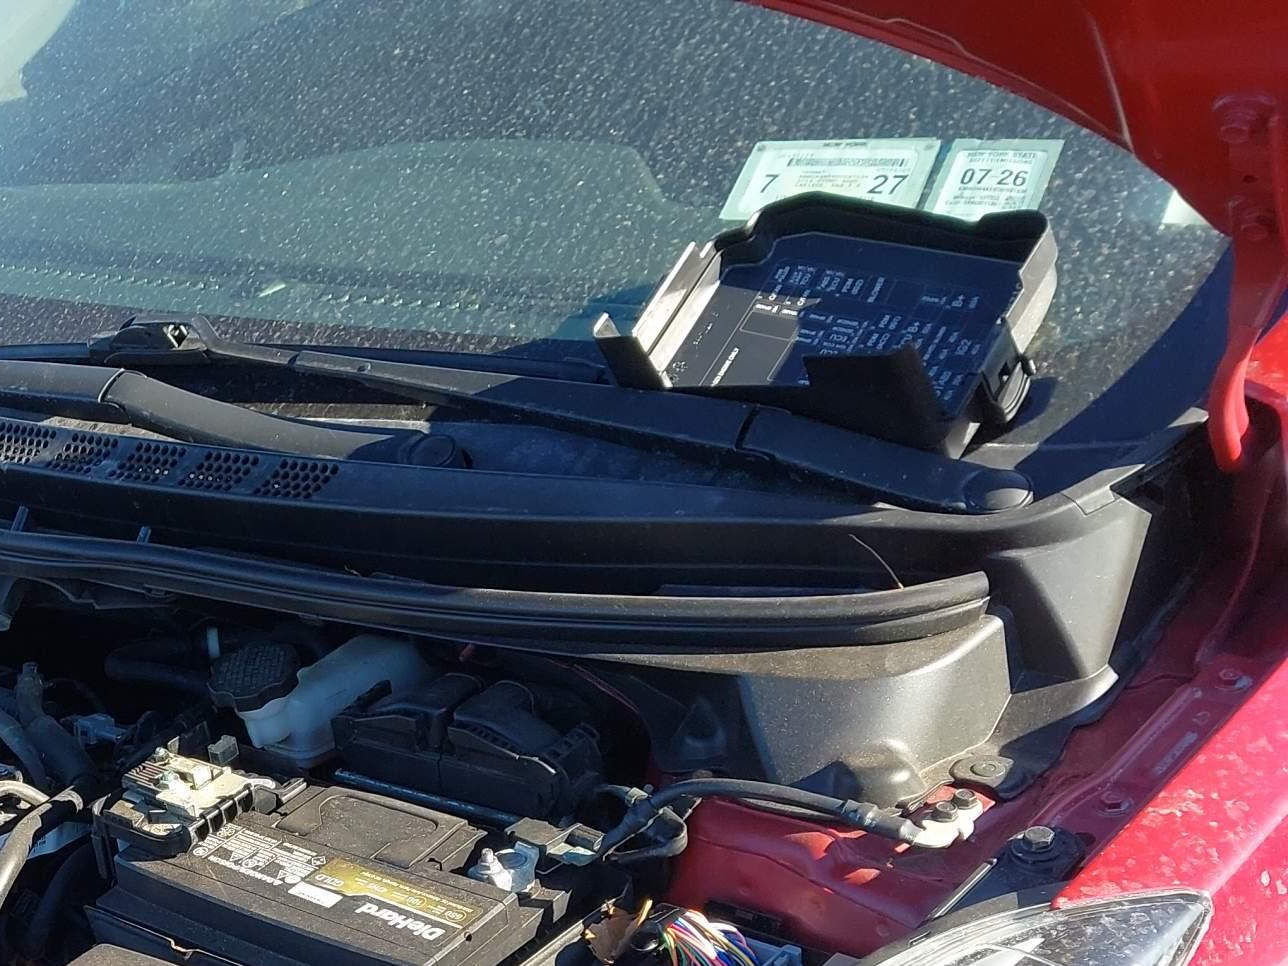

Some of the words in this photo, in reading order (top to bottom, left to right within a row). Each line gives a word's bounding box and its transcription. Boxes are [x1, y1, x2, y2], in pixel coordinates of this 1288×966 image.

[760, 174, 781, 193] 7
[867, 175, 909, 194] 27
[317, 873, 344, 887] GOLD
[353, 901, 446, 942] DieHard
